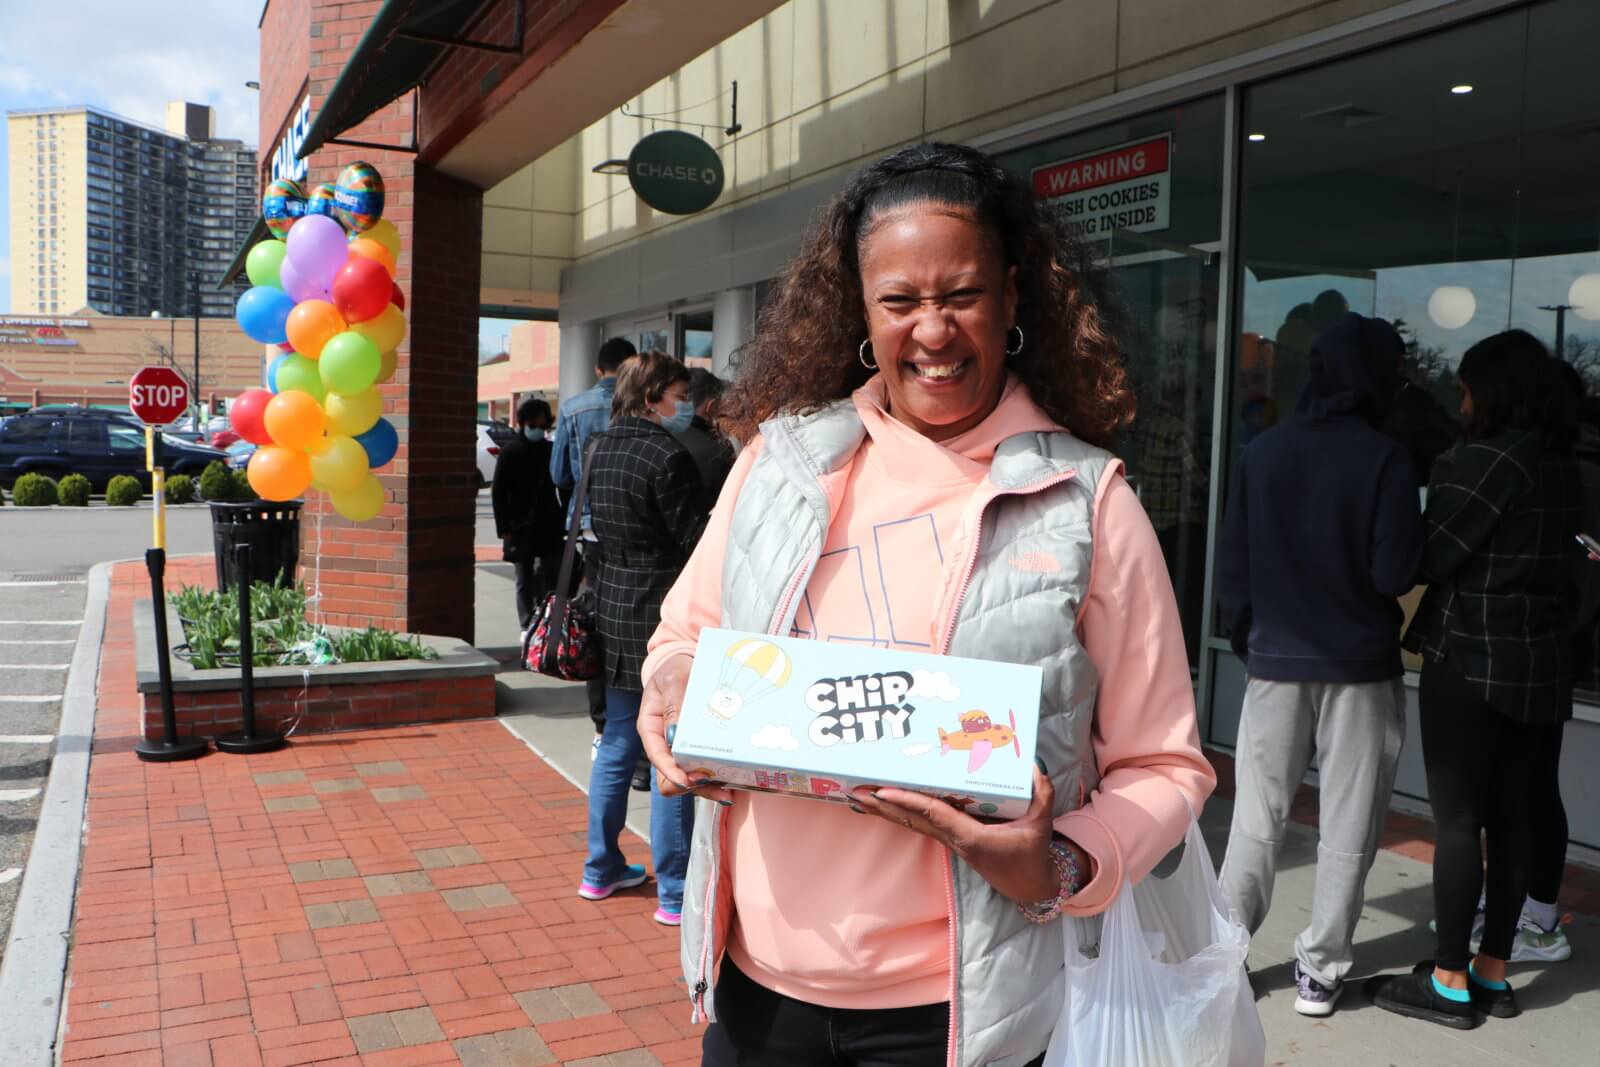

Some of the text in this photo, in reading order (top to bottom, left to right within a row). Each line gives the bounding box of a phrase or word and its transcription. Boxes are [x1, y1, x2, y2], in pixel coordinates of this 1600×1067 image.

[636, 162, 697, 181] CHASE
[1049, 151, 1146, 191] WARNING
[1088, 182, 1160, 212] COOKIES
[1100, 206, 1156, 232] INSIDE
[132, 384, 185, 407] STOP
